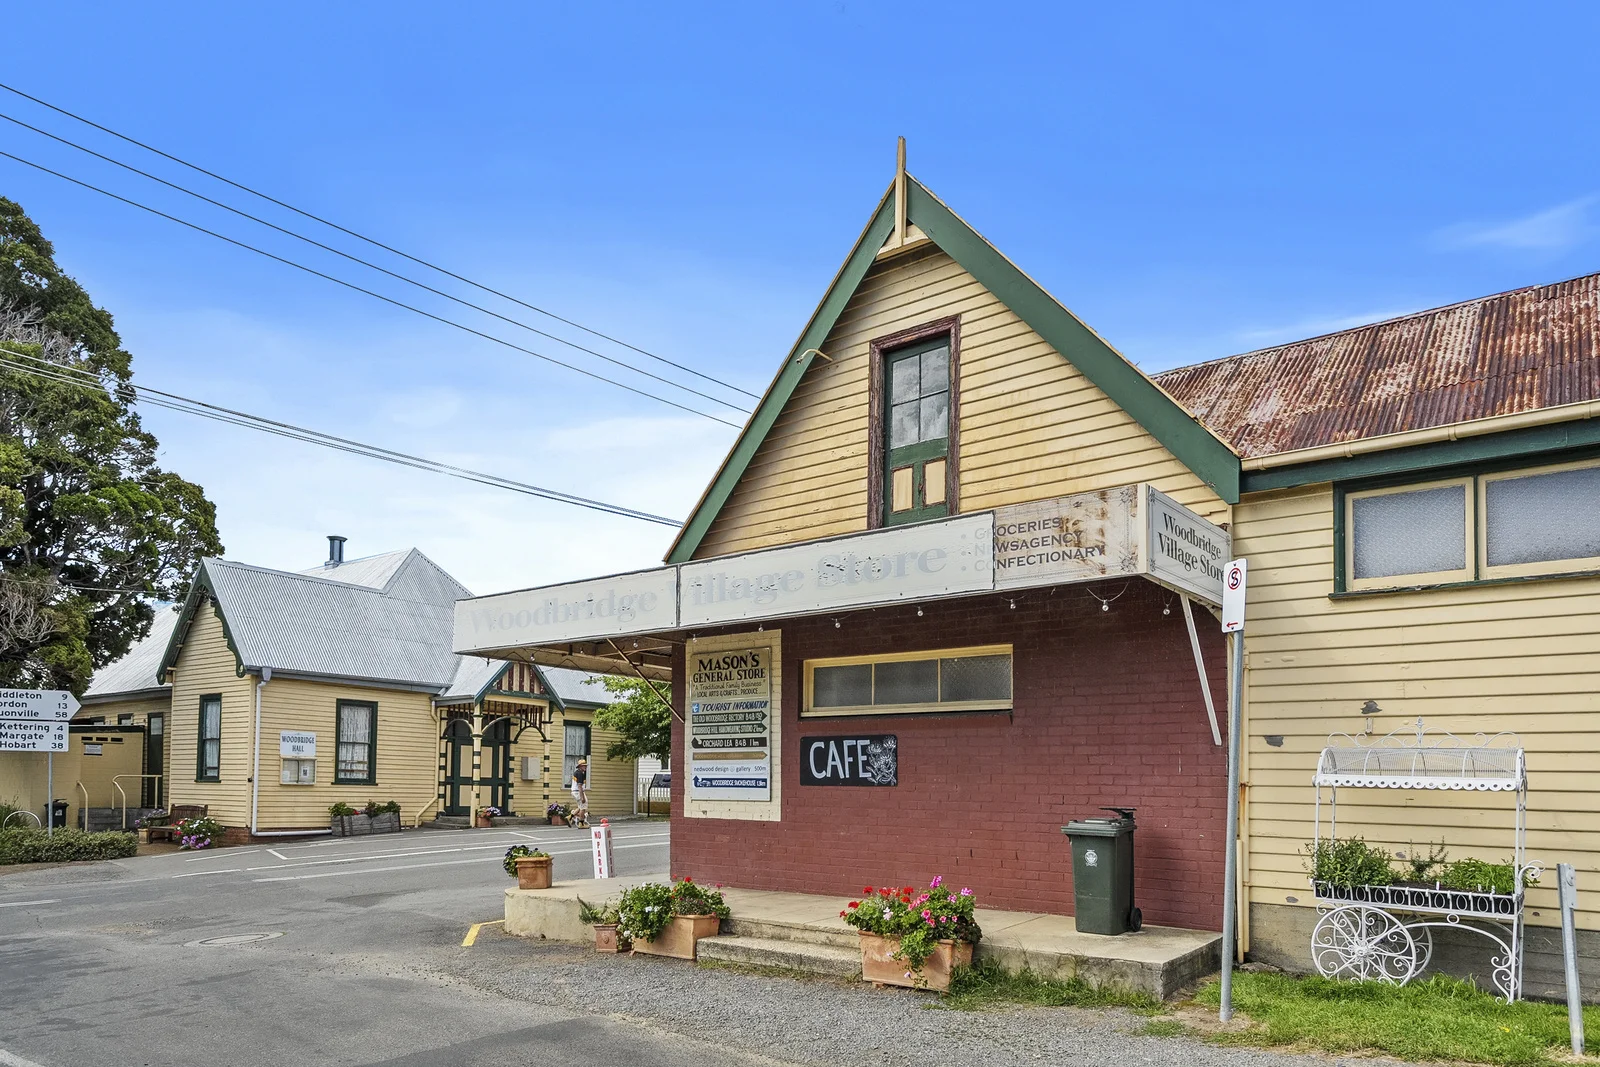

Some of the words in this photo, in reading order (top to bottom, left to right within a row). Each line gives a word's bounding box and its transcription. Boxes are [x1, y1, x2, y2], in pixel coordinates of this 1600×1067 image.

[1163, 512, 1221, 561] Woodbridge
[1157, 531, 1198, 572] Village
[468, 589, 657, 634] Woodbridge
[667, 565, 805, 607] Village
[817, 547, 948, 590] Store
[698, 651, 760, 672] MASON'S
[692, 670, 735, 683] GENERAL
[736, 668, 766, 681] STORE
[699, 682, 725, 691] Traditional
[725, 681, 740, 690] Family
[701, 702, 732, 712] TOURIST
[732, 701, 769, 710] INFORMATION
[0, 723, 50, 733] Kettering
[0, 732, 44, 741] Margate
[702, 739, 724, 748] ORCHARD
[809, 739, 872, 779] CAFE
[594, 831, 601, 839] NO
